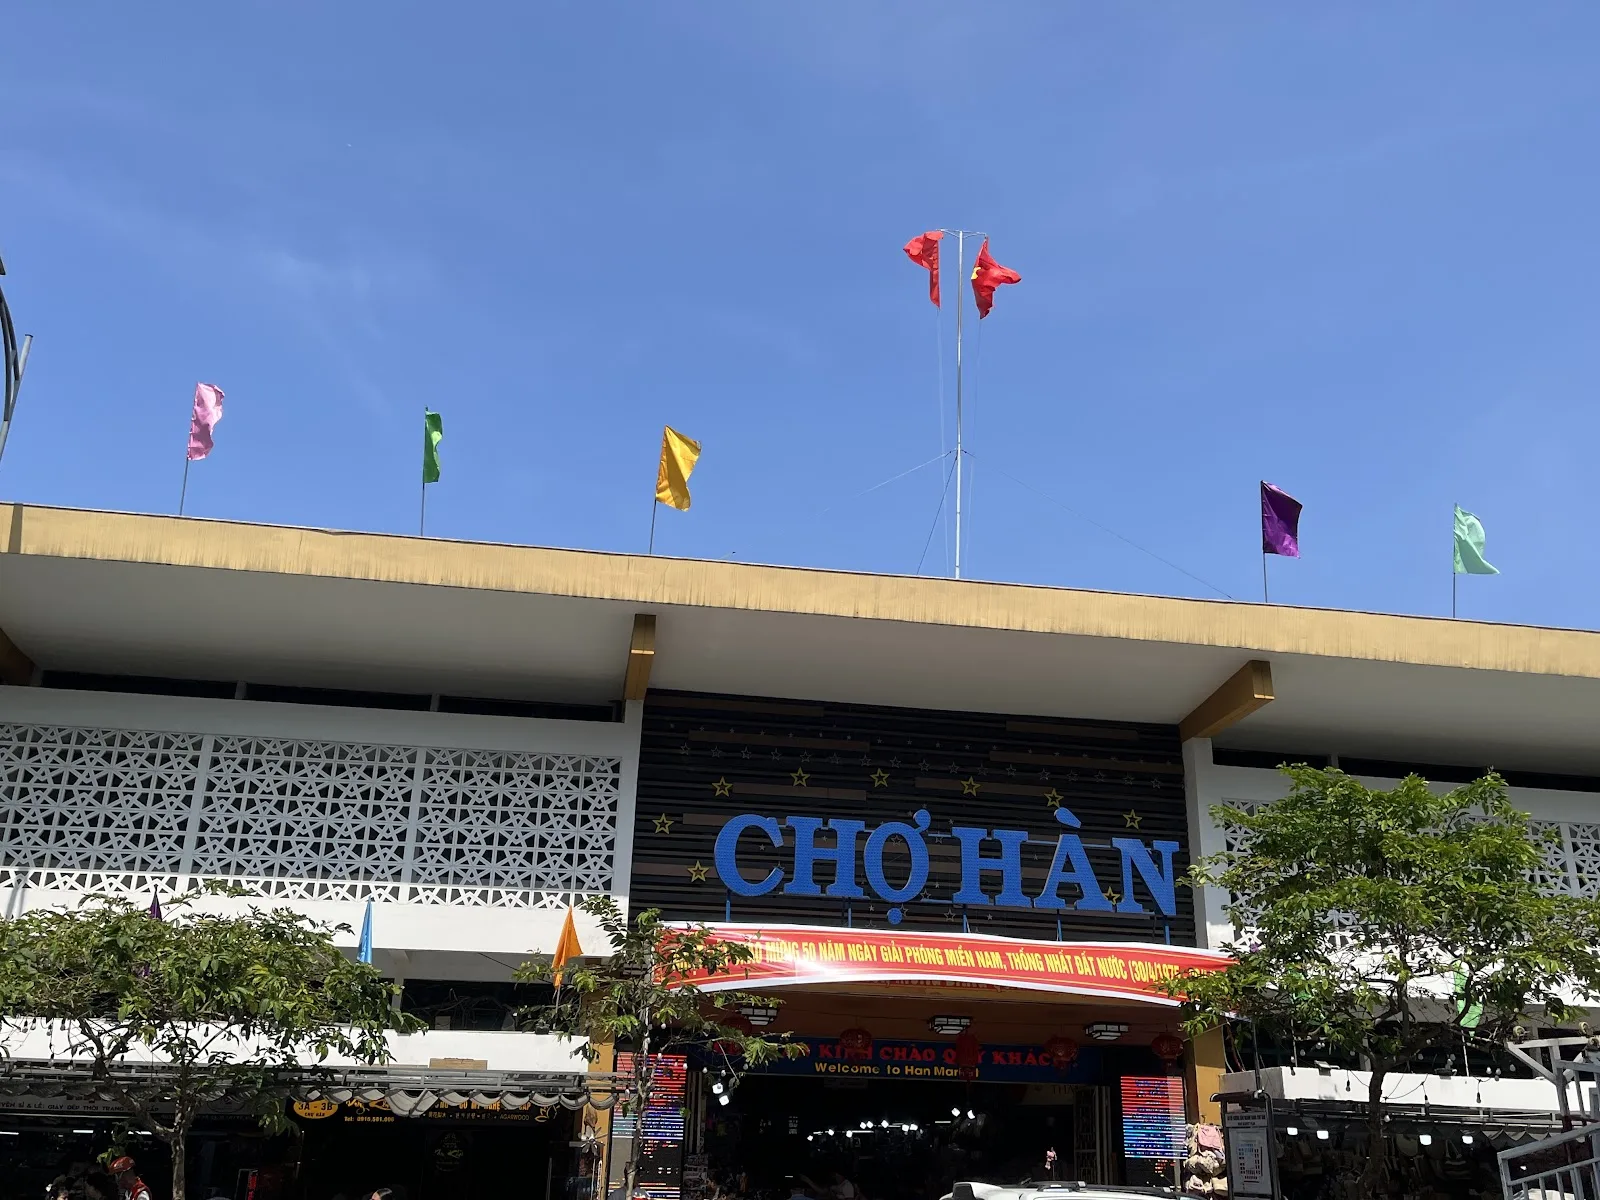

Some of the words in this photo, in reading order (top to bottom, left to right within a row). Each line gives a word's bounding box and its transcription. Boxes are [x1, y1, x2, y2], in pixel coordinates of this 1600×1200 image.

[713, 808, 932, 925] CHỢ
[951, 806, 1180, 916] HÀN
[765, 940, 799, 963] MỪNG
[802, 942, 816, 962] 50
[818, 940, 846, 962] NĂM
[847, 941, 878, 963] NGÀY
[880, 940, 904, 963] GIẢI
[904, 944, 944, 965] PHÓNG
[944, 945, 975, 967] MIỀN
[975, 951, 1007, 971] NAM,
[1005, 947, 1045, 972] THỐNG
[1044, 949, 1074, 974] NHẤT
[1073, 951, 1097, 976] ĐẤT
[1096, 955, 1128, 980] NƯỚC
[880, 1043, 936, 1061] CHÀO
[942, 1044, 986, 1064] QÝ
[991, 1047, 1066, 1067] KHÁC
[815, 1062, 880, 1074] Welcome
[886, 1065, 900, 1075] to
[904, 1065, 931, 1076] Han
[298, 1102, 310, 1111] 3A
[321, 1102, 333, 1111] 3B
